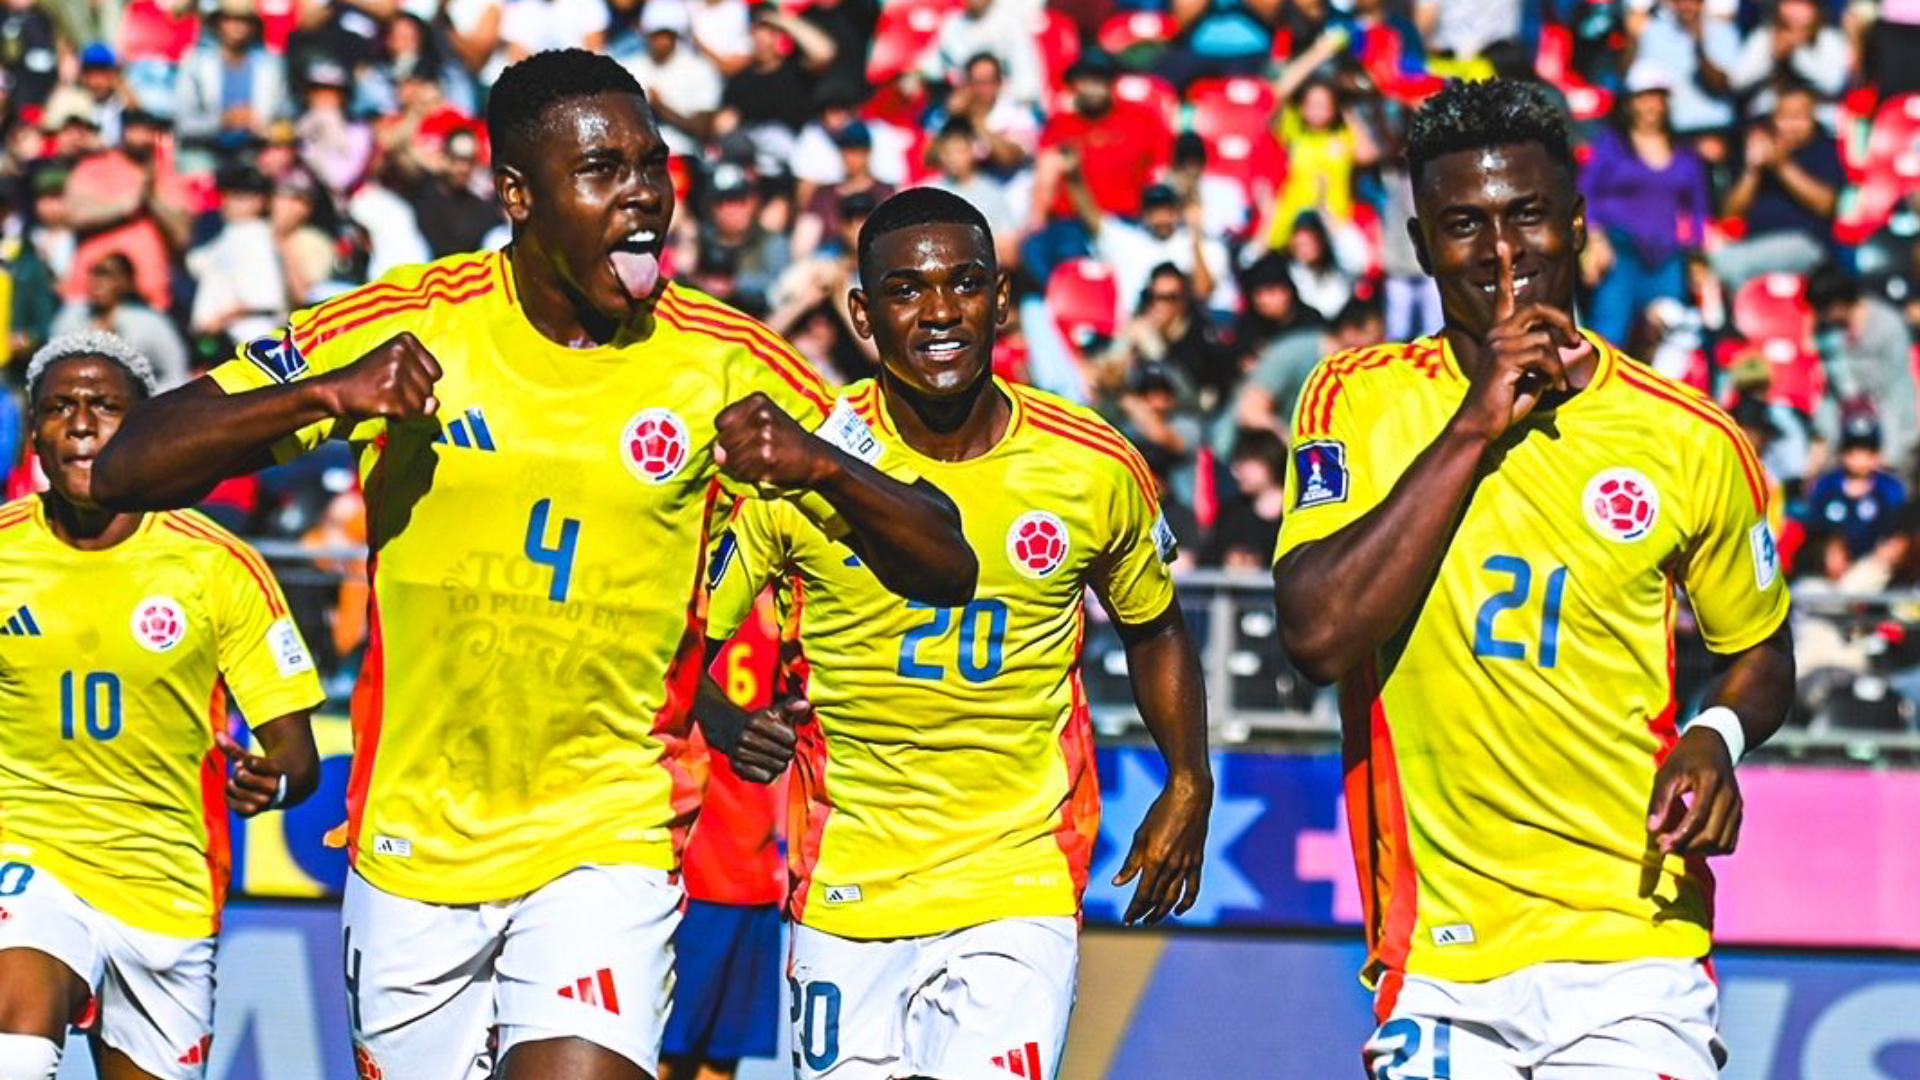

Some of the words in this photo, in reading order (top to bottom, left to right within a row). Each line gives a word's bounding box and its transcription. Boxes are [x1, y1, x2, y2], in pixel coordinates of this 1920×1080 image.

[466, 550, 610, 598] TOO
[524, 497, 581, 603] 4
[448, 592, 480, 615] LO
[489, 592, 584, 623] PUEDO
[591, 604, 622, 633] EN
[896, 598, 1009, 684] 20
[1473, 553, 1567, 668] 21
[60, 669, 122, 742] 10
[726, 642, 758, 707] 6
[343, 926, 362, 1032] 4
[1375, 1018, 1451, 1080] 21
